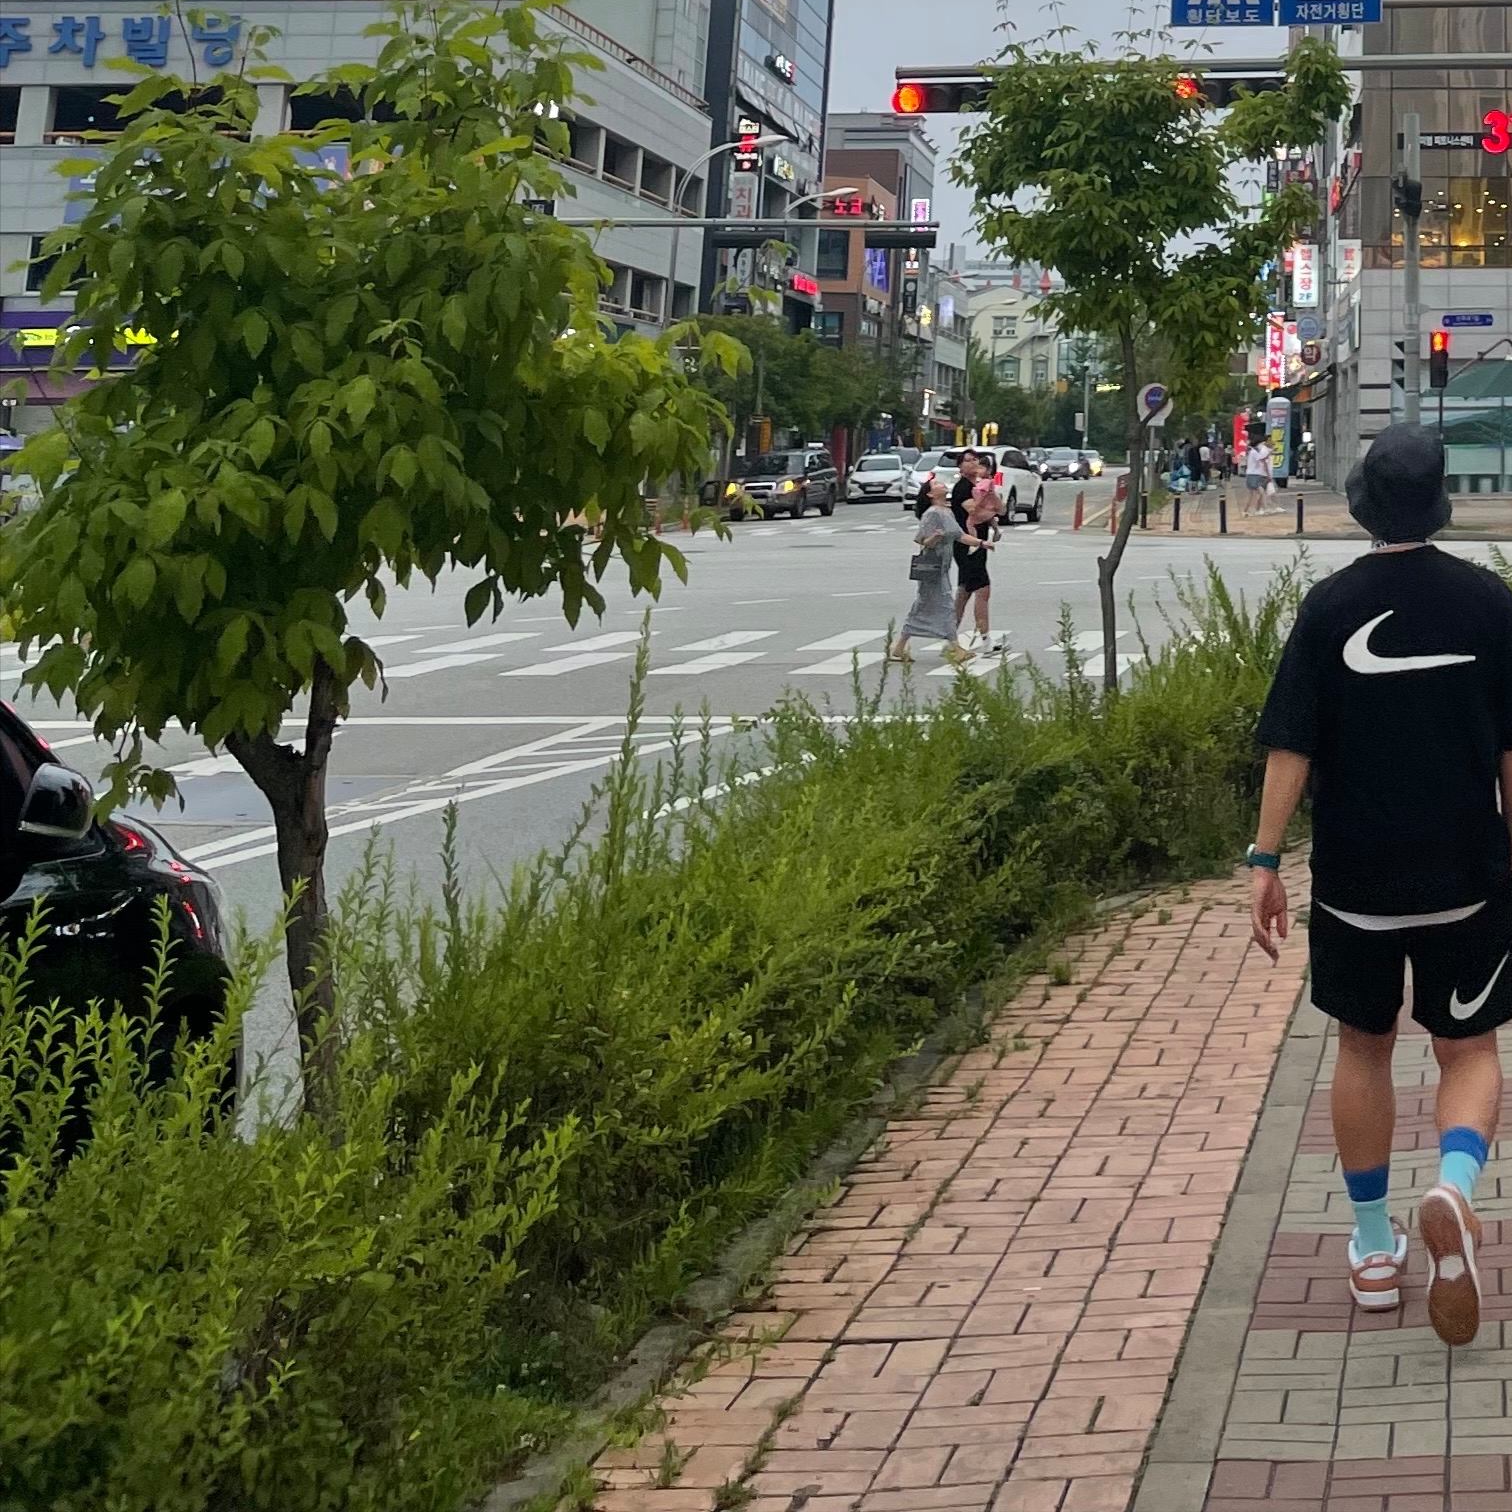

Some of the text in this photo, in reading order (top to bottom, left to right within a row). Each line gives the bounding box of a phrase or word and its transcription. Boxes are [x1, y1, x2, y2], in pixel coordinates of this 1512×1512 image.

[1186, 7, 1261, 24] 횡단보도
[1296, 2, 1364, 20] 자전거횡단
[1299, 248, 1313, 291] 헬스장
[1298, 292, 1313, 301] 2F
